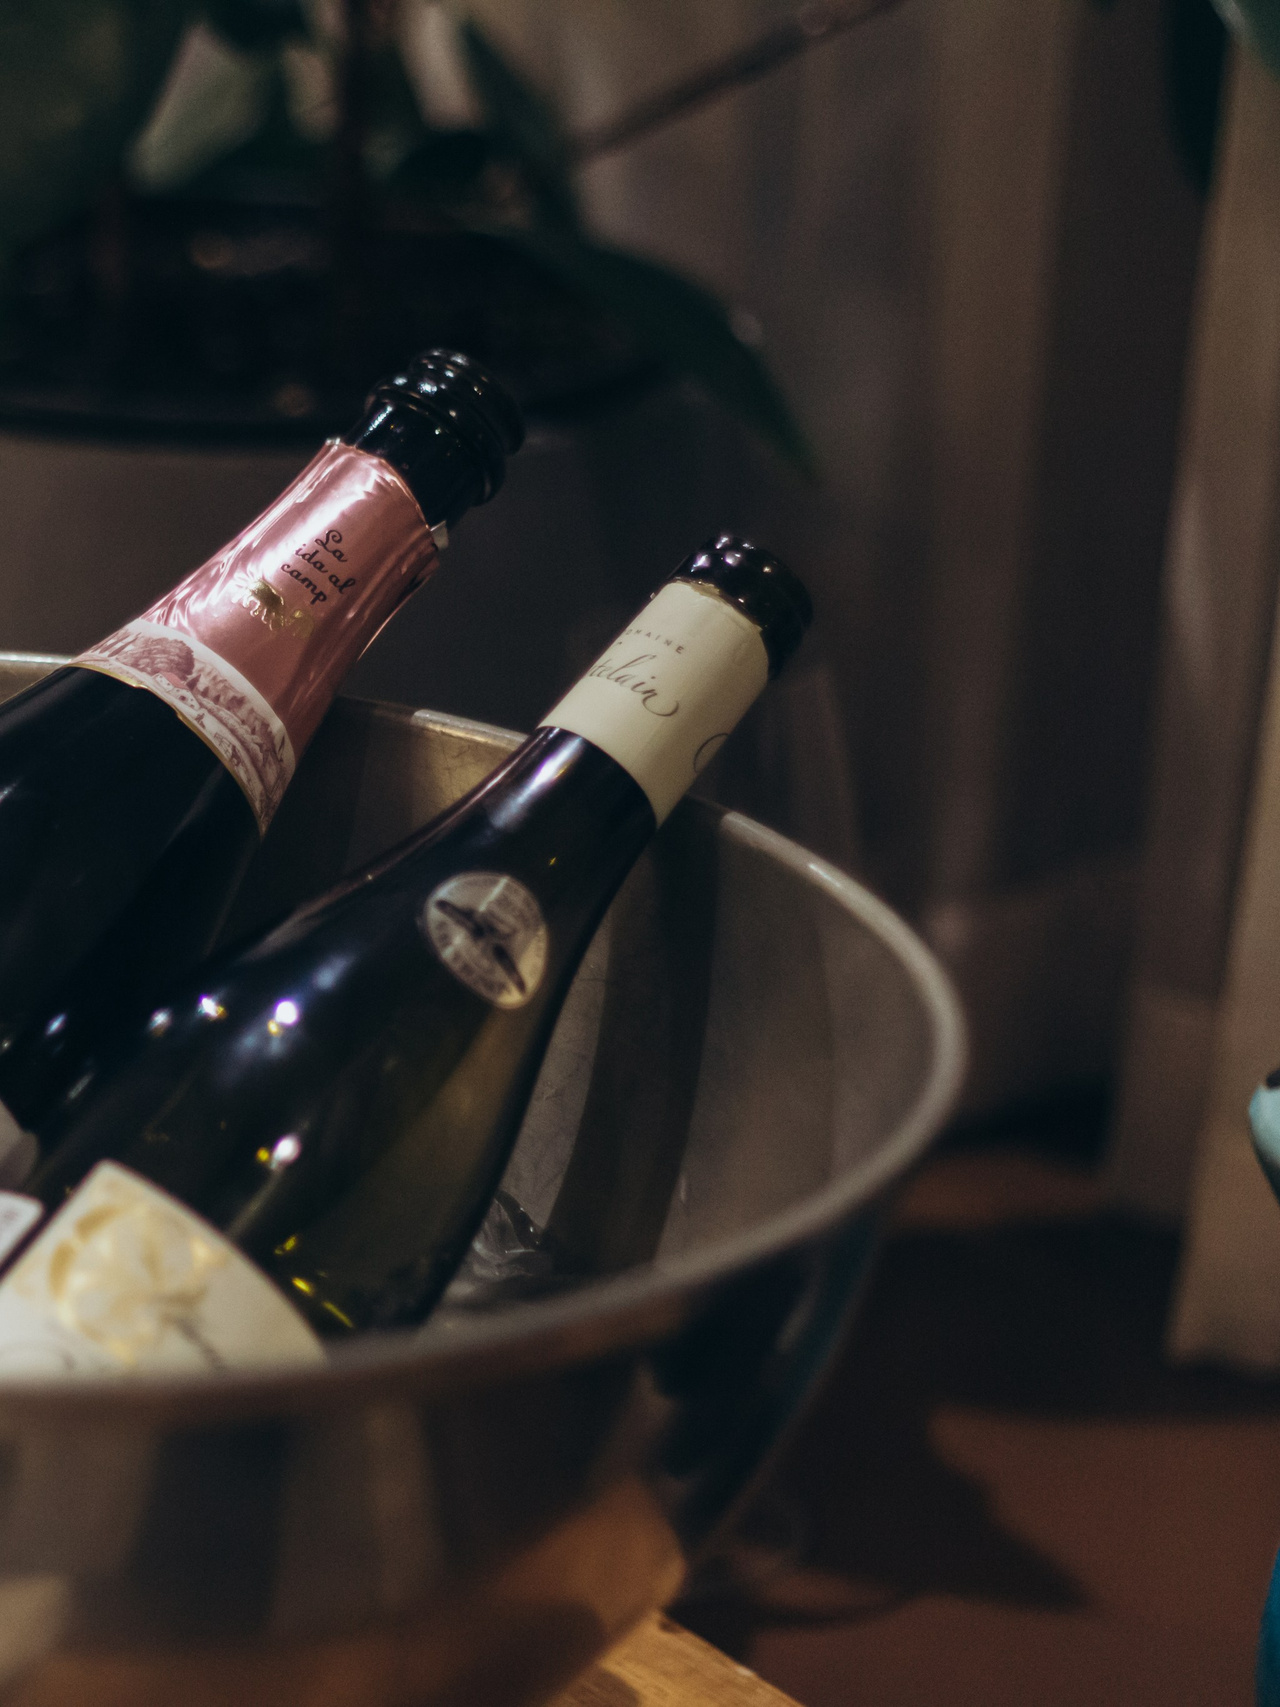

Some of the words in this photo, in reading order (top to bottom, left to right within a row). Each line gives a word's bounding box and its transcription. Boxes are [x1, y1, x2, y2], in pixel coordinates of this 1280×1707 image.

[315, 529, 348, 563] La
[280, 563, 328, 605] camp
[294, 543, 329, 573] ida
[329, 574, 356, 595] al
[623, 628, 685, 655] OMAINE
[586, 653, 680, 717] telain
